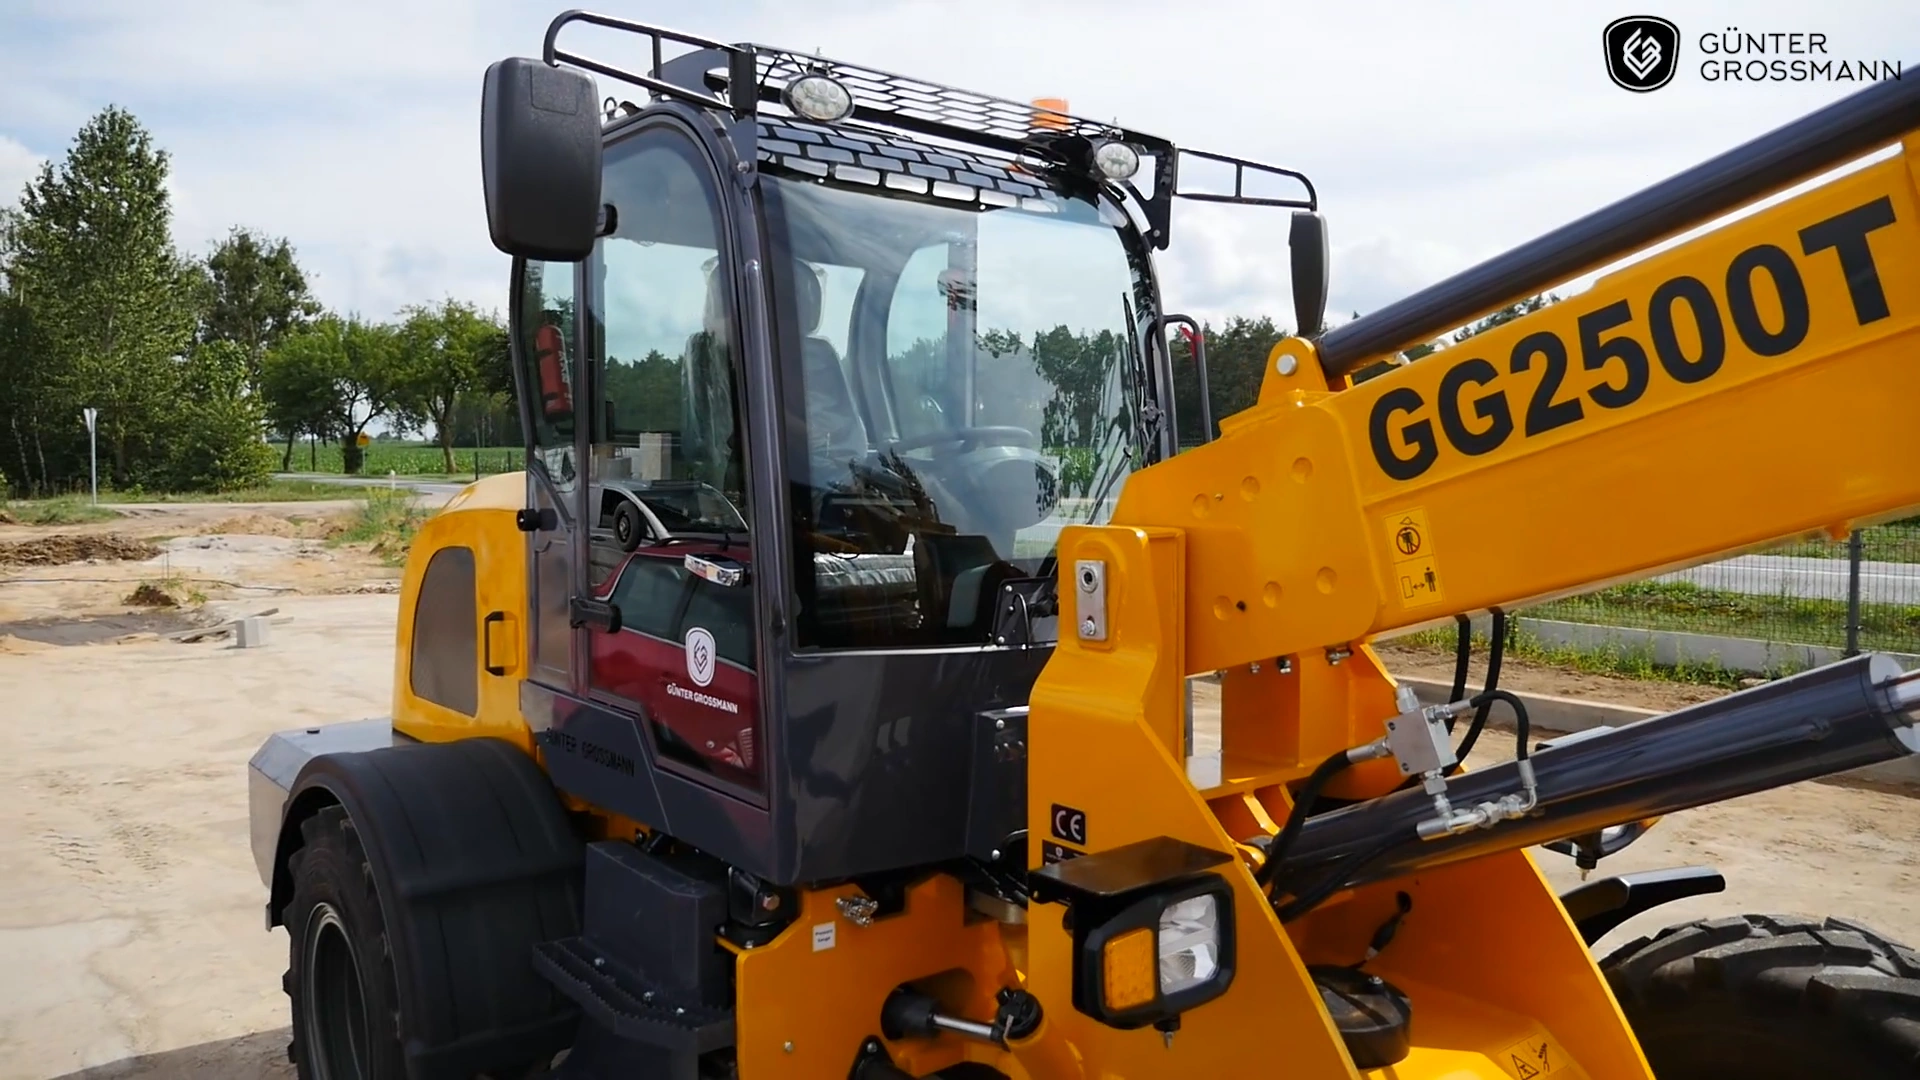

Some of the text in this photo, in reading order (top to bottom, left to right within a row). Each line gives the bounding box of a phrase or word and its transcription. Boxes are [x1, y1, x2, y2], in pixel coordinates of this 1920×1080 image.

[1368, 195, 1896, 481] GG2500T
[667, 683, 738, 714] GÜNTER GROSSMANN
[1055, 810, 1082, 841] CE
